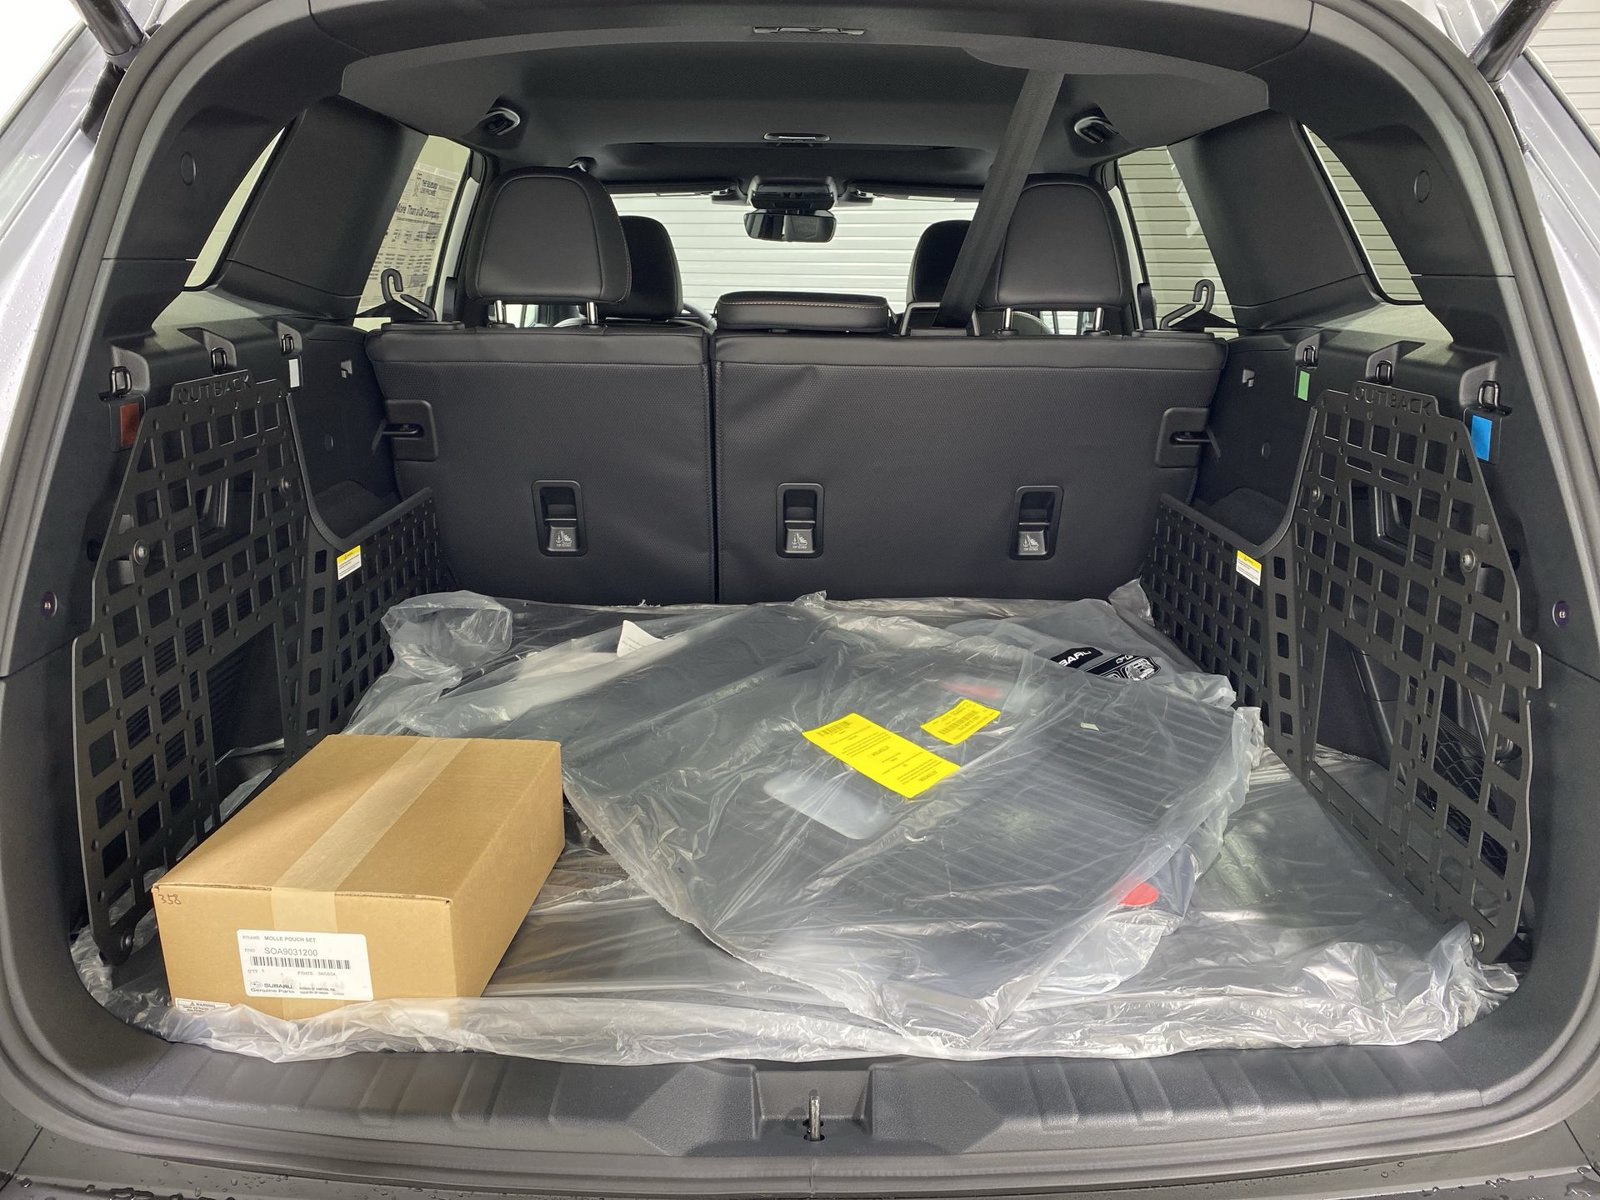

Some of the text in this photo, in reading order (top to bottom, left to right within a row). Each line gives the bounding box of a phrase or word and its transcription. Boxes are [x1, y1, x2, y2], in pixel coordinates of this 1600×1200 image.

[178, 374, 251, 405] OUTBACK
[1353, 386, 1431, 417] OUTBACK
[264, 946, 319, 957] SOA9031200
